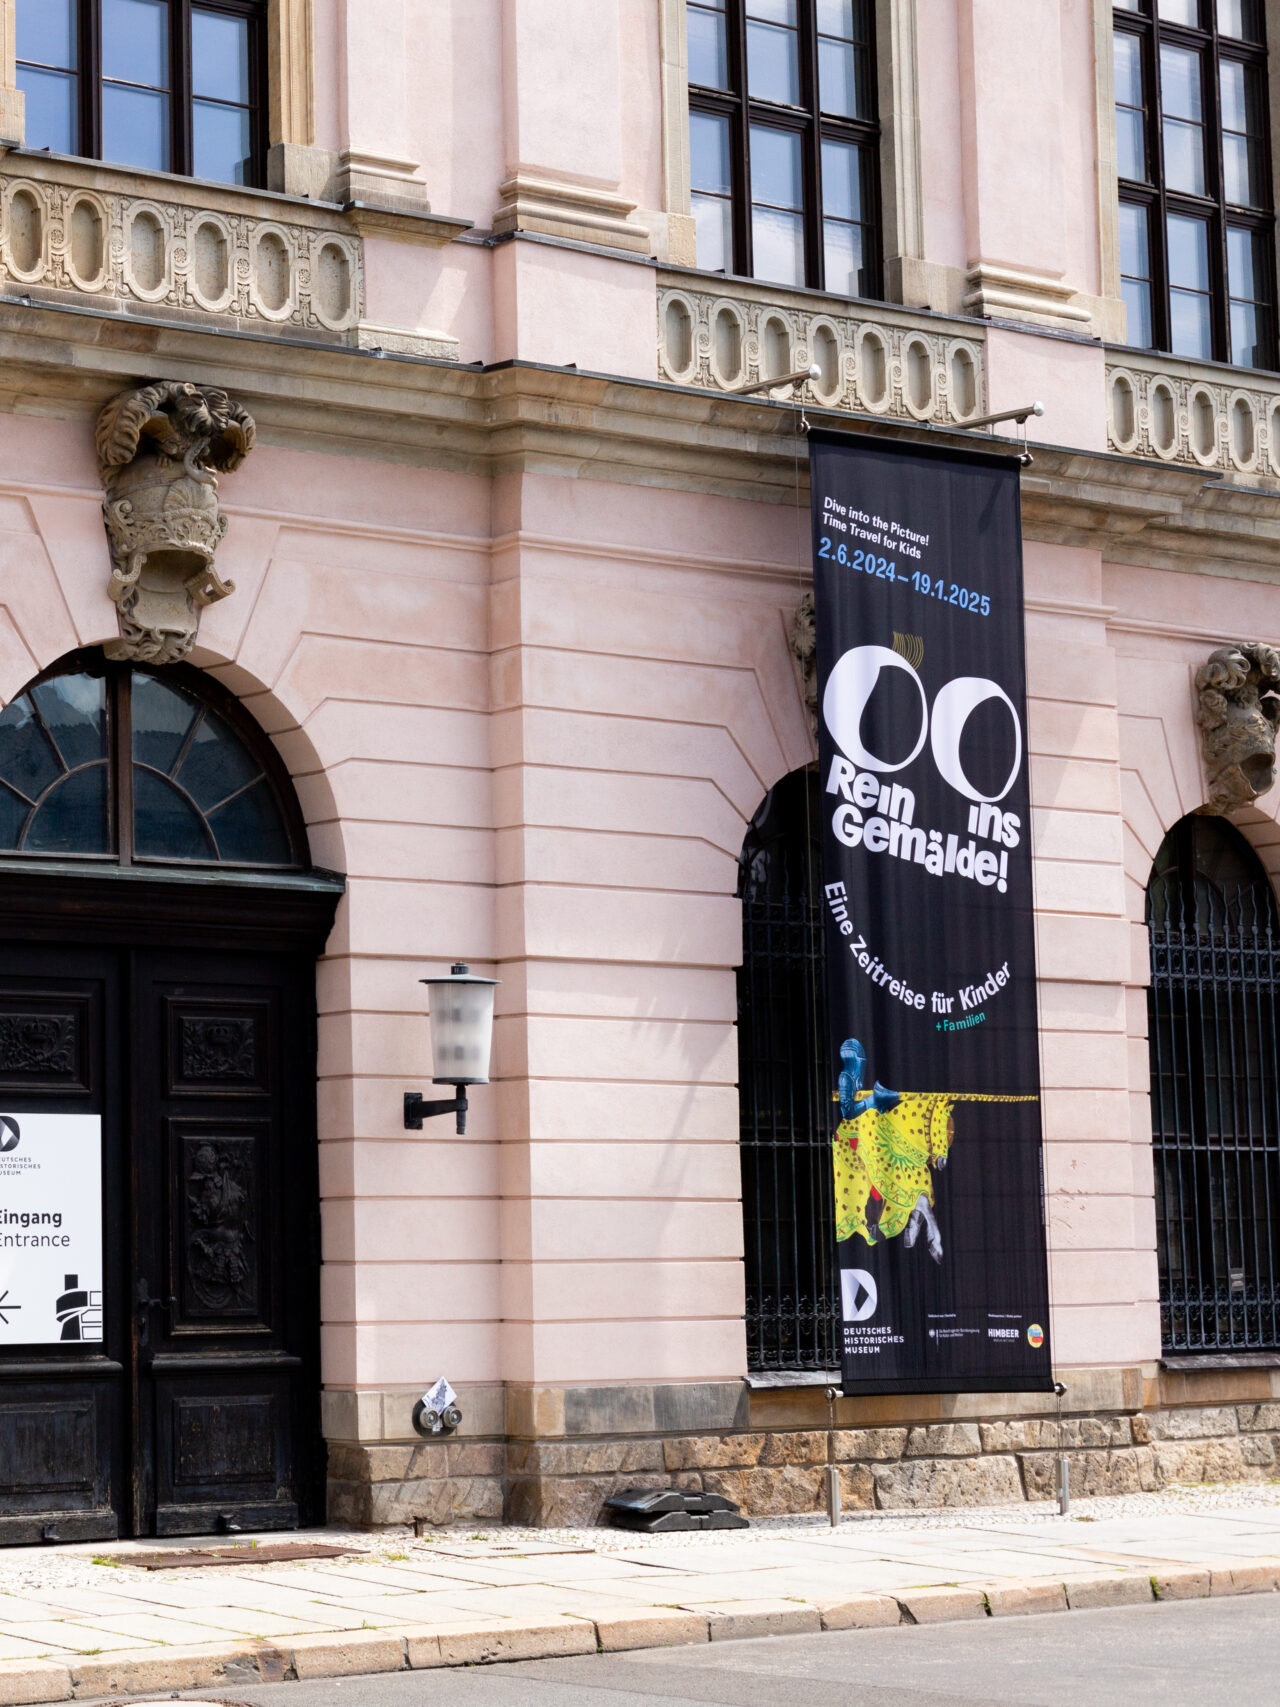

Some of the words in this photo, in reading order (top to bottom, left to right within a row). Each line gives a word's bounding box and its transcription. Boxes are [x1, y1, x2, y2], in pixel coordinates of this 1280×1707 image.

[822, 512, 847, 532] Time
[849, 522, 881, 544] Travel
[883, 535, 898, 550] for
[899, 541, 922, 559] Kids
[824, 496, 846, 516] Dive
[848, 506, 870, 524] into
[872, 515, 889, 531] the
[890, 521, 930, 546] Picture!
[826, 754, 915, 826] Rein
[968, 802, 1021, 848] ins
[831, 803, 1008, 894] Gemälde!
[824, 881, 854, 936] Eine
[849, 934, 926, 1010] Zeitreise
[931, 991, 955, 1014] für
[958, 961, 1012, 1011] Kinder
[843, 1326, 892, 1336] DEUTSCHES
[844, 1335, 905, 1345] HISTORISCHES
[844, 1345, 881, 1354] MUSEUM
[988, 1328, 1020, 1338] HIMBEER
